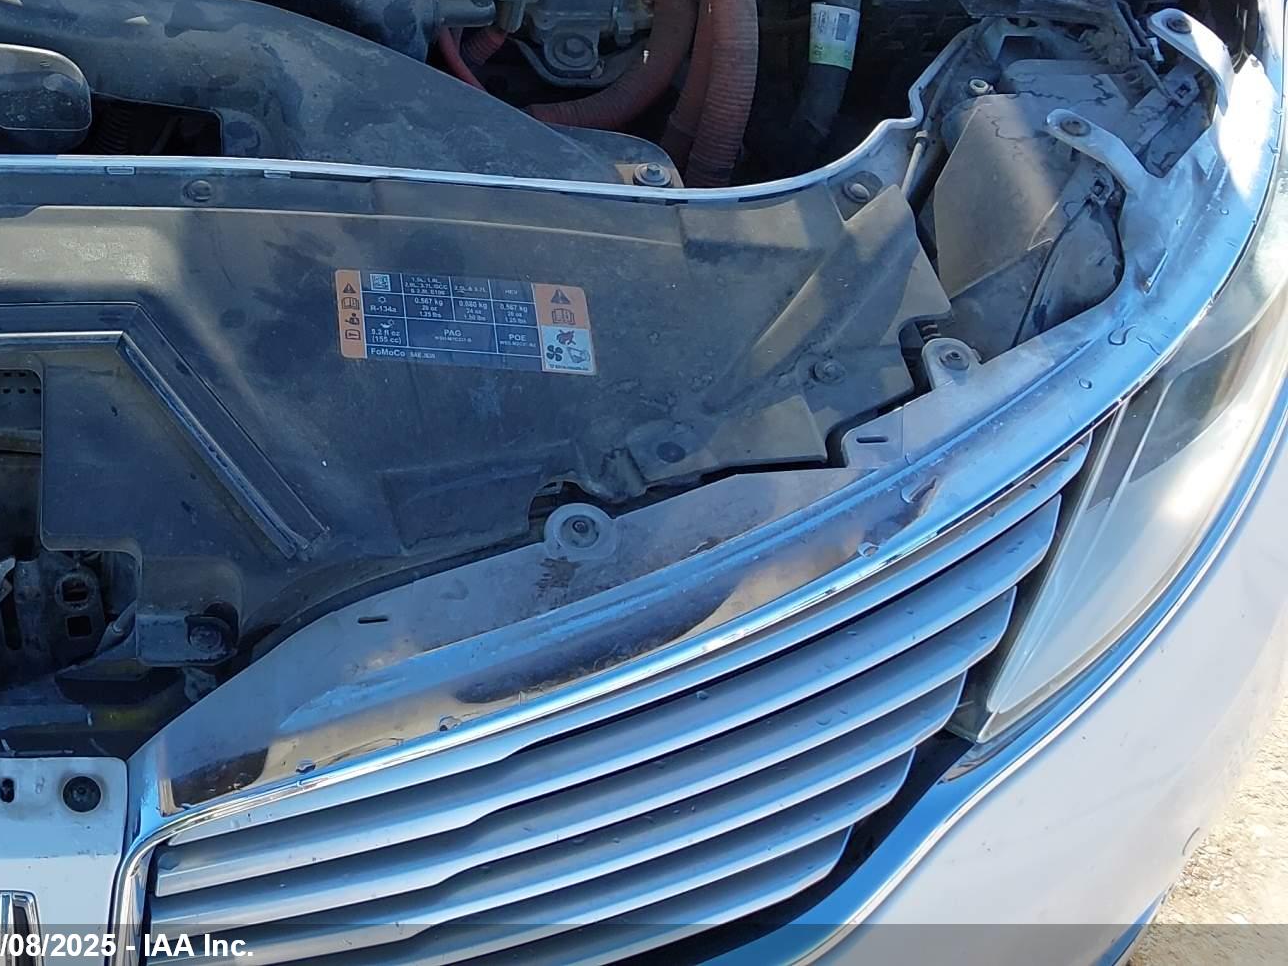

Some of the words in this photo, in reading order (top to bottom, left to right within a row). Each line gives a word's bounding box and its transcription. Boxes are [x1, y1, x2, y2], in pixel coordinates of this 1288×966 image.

[444, 329, 462, 337] PAG
[508, 333, 527, 342] POE
[371, 347, 406, 357] FoMoCo
